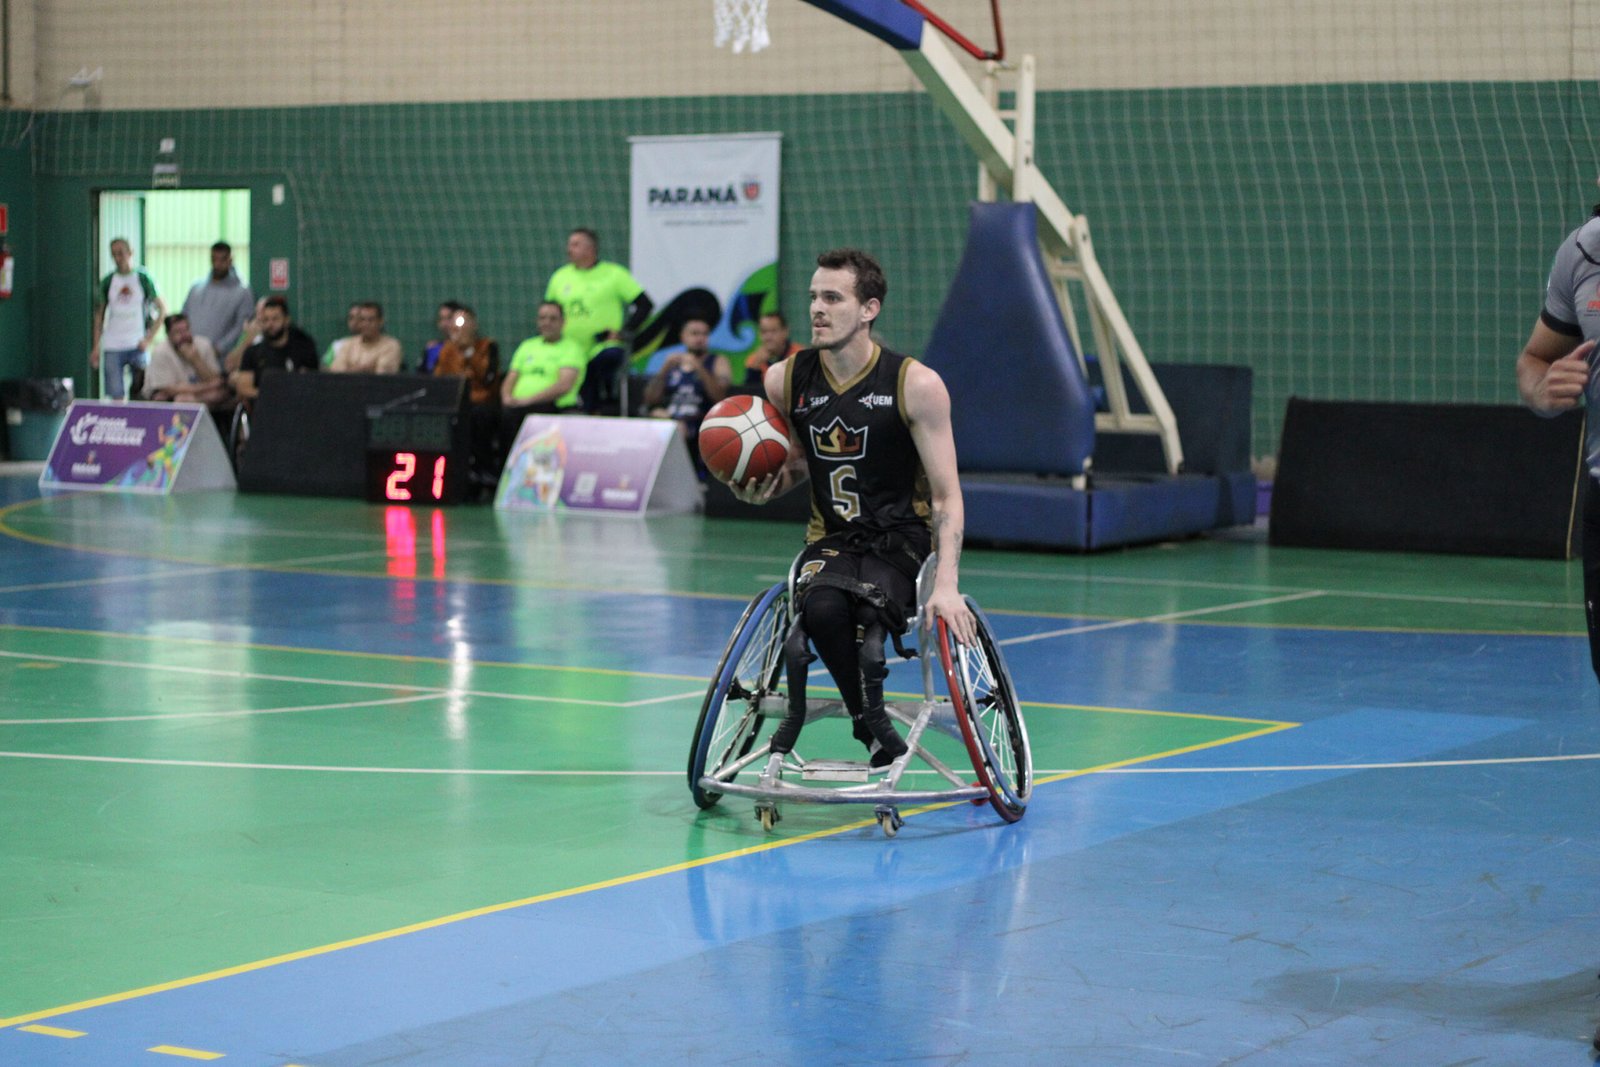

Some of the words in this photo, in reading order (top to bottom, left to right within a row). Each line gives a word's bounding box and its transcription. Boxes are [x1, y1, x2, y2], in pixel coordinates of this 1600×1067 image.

[648, 184, 737, 204] PARANÁ
[873, 395, 893, 406] UEM
[829, 464, 861, 521] 5
